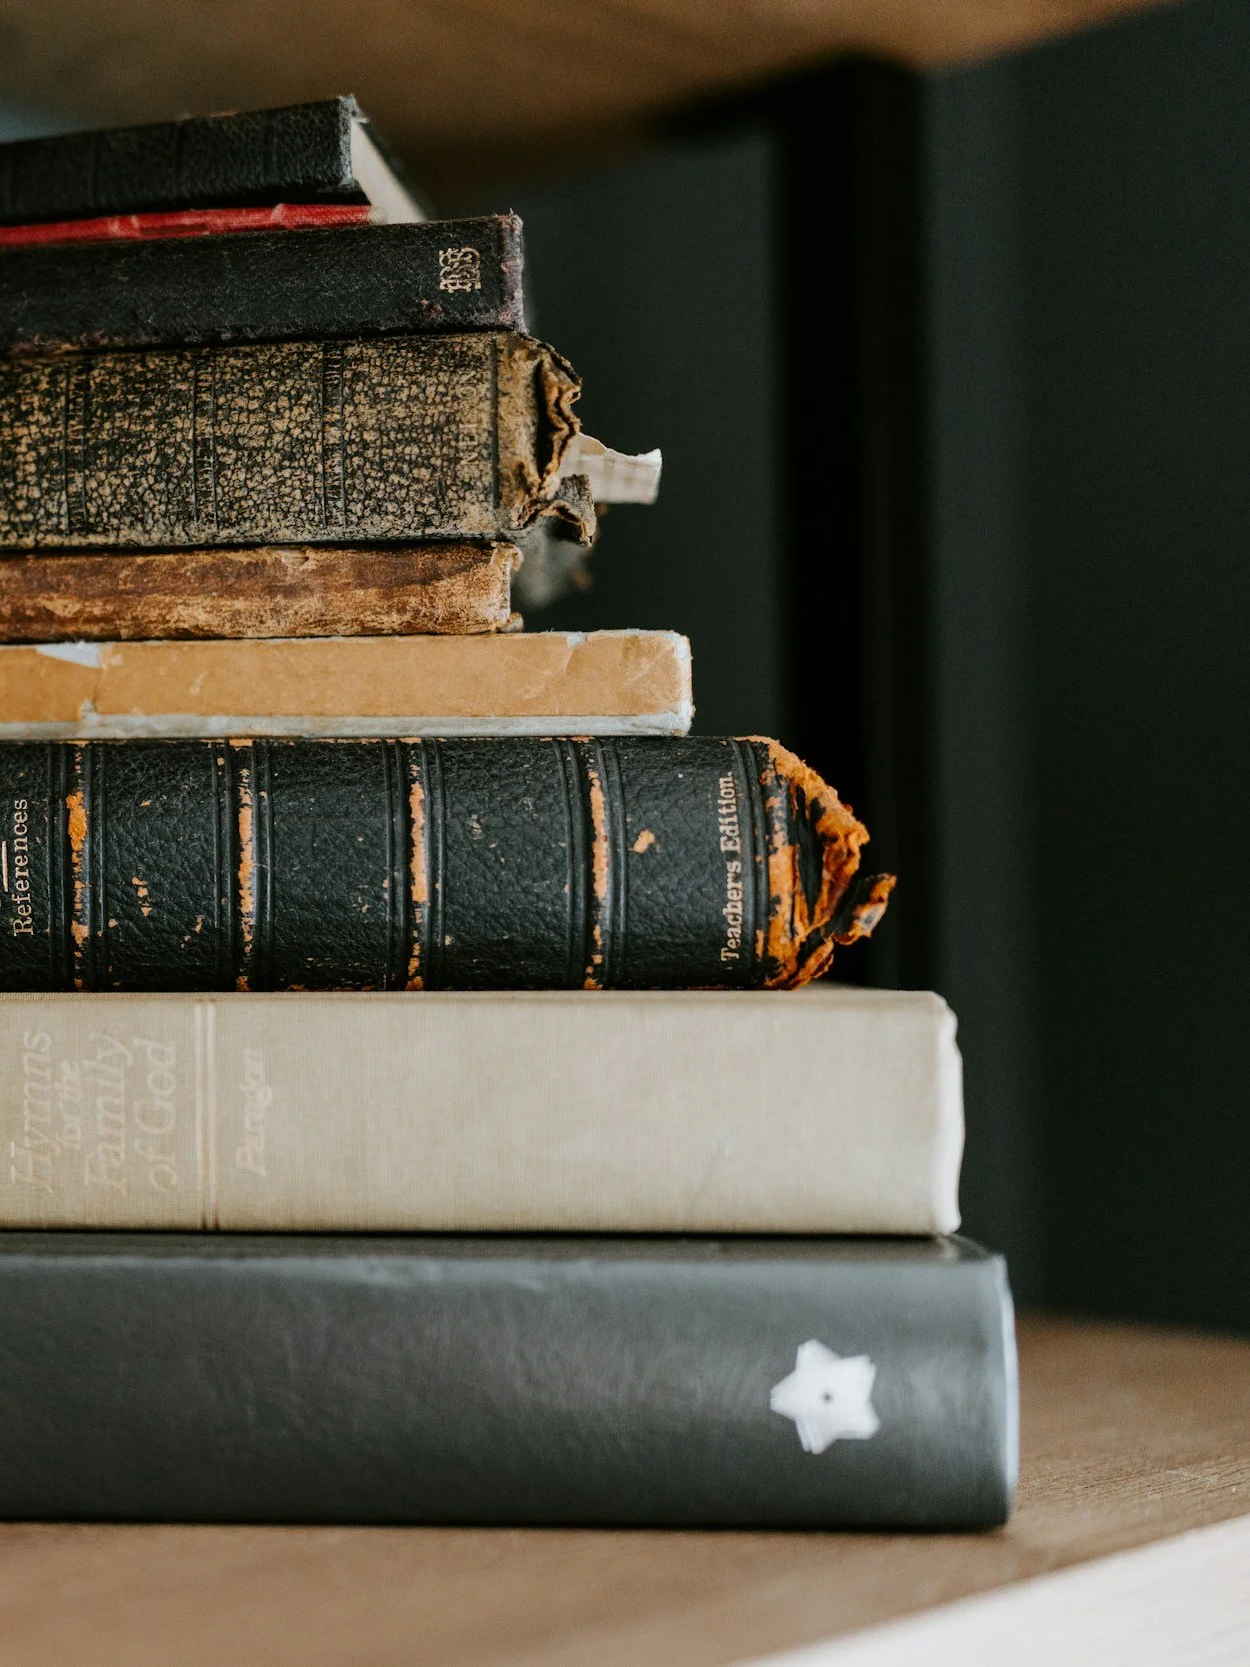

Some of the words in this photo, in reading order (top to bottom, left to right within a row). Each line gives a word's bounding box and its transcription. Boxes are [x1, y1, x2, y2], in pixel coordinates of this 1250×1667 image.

[12, 799, 34, 936] References
[718, 771, 742, 854] Edition.
[10, 1031, 61, 1194] Hymns
[84, 1032, 133, 1195] Family
[133, 1037, 176, 1134] God
[134, 1139, 178, 1191] of
